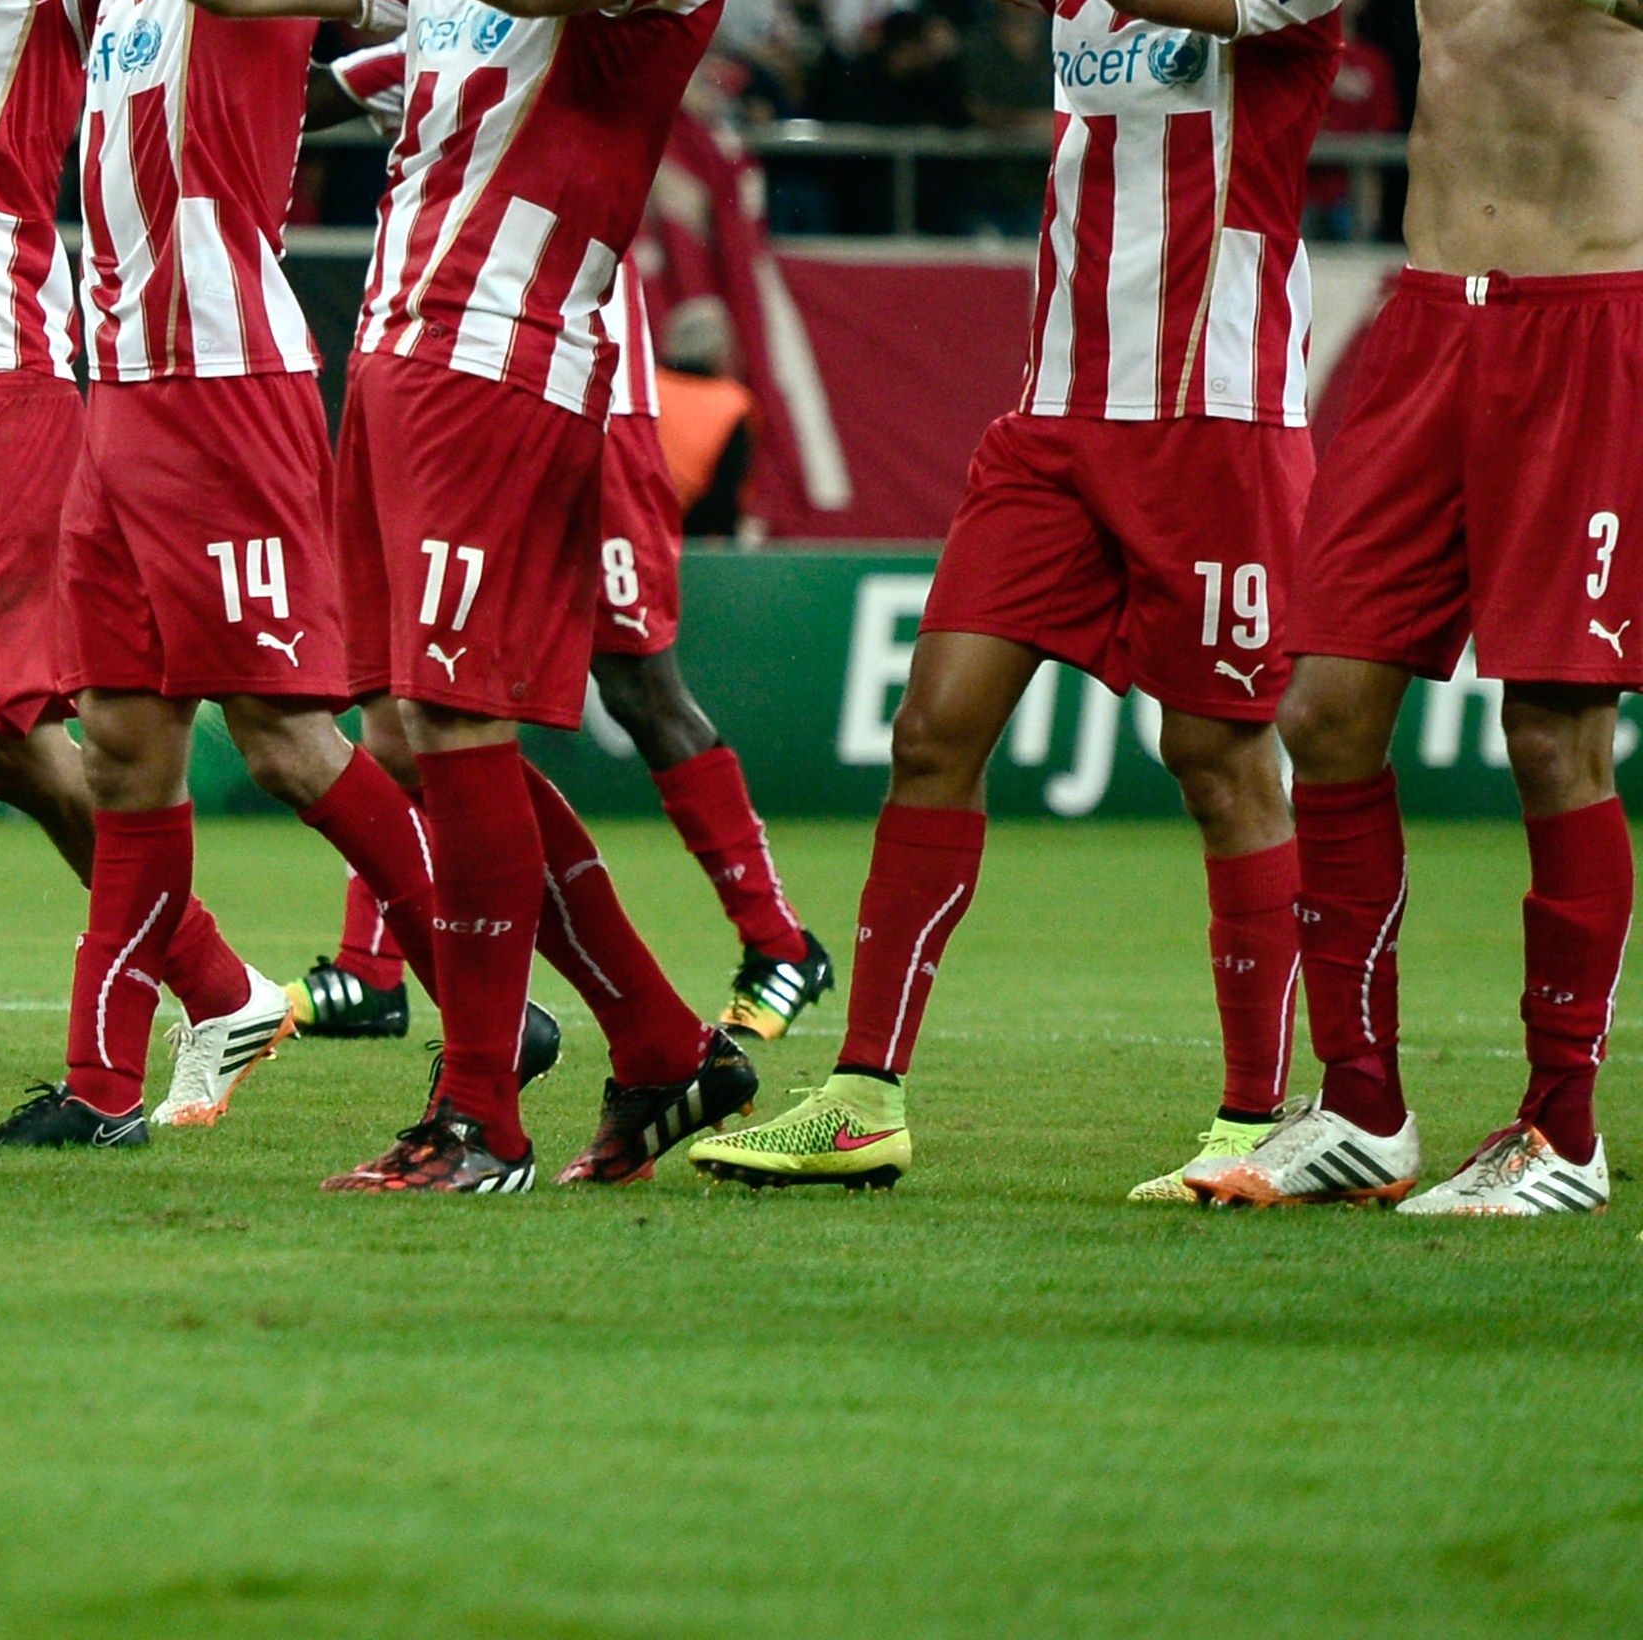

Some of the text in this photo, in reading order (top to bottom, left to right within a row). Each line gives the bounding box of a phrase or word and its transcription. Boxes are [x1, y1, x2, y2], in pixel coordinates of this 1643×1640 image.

[1056, 32, 1147, 88] nicef
[207, 537, 290, 623] 14
[601, 537, 639, 607] 8
[1586, 511, 1620, 600] 3
[1194, 561, 1270, 649] 19
